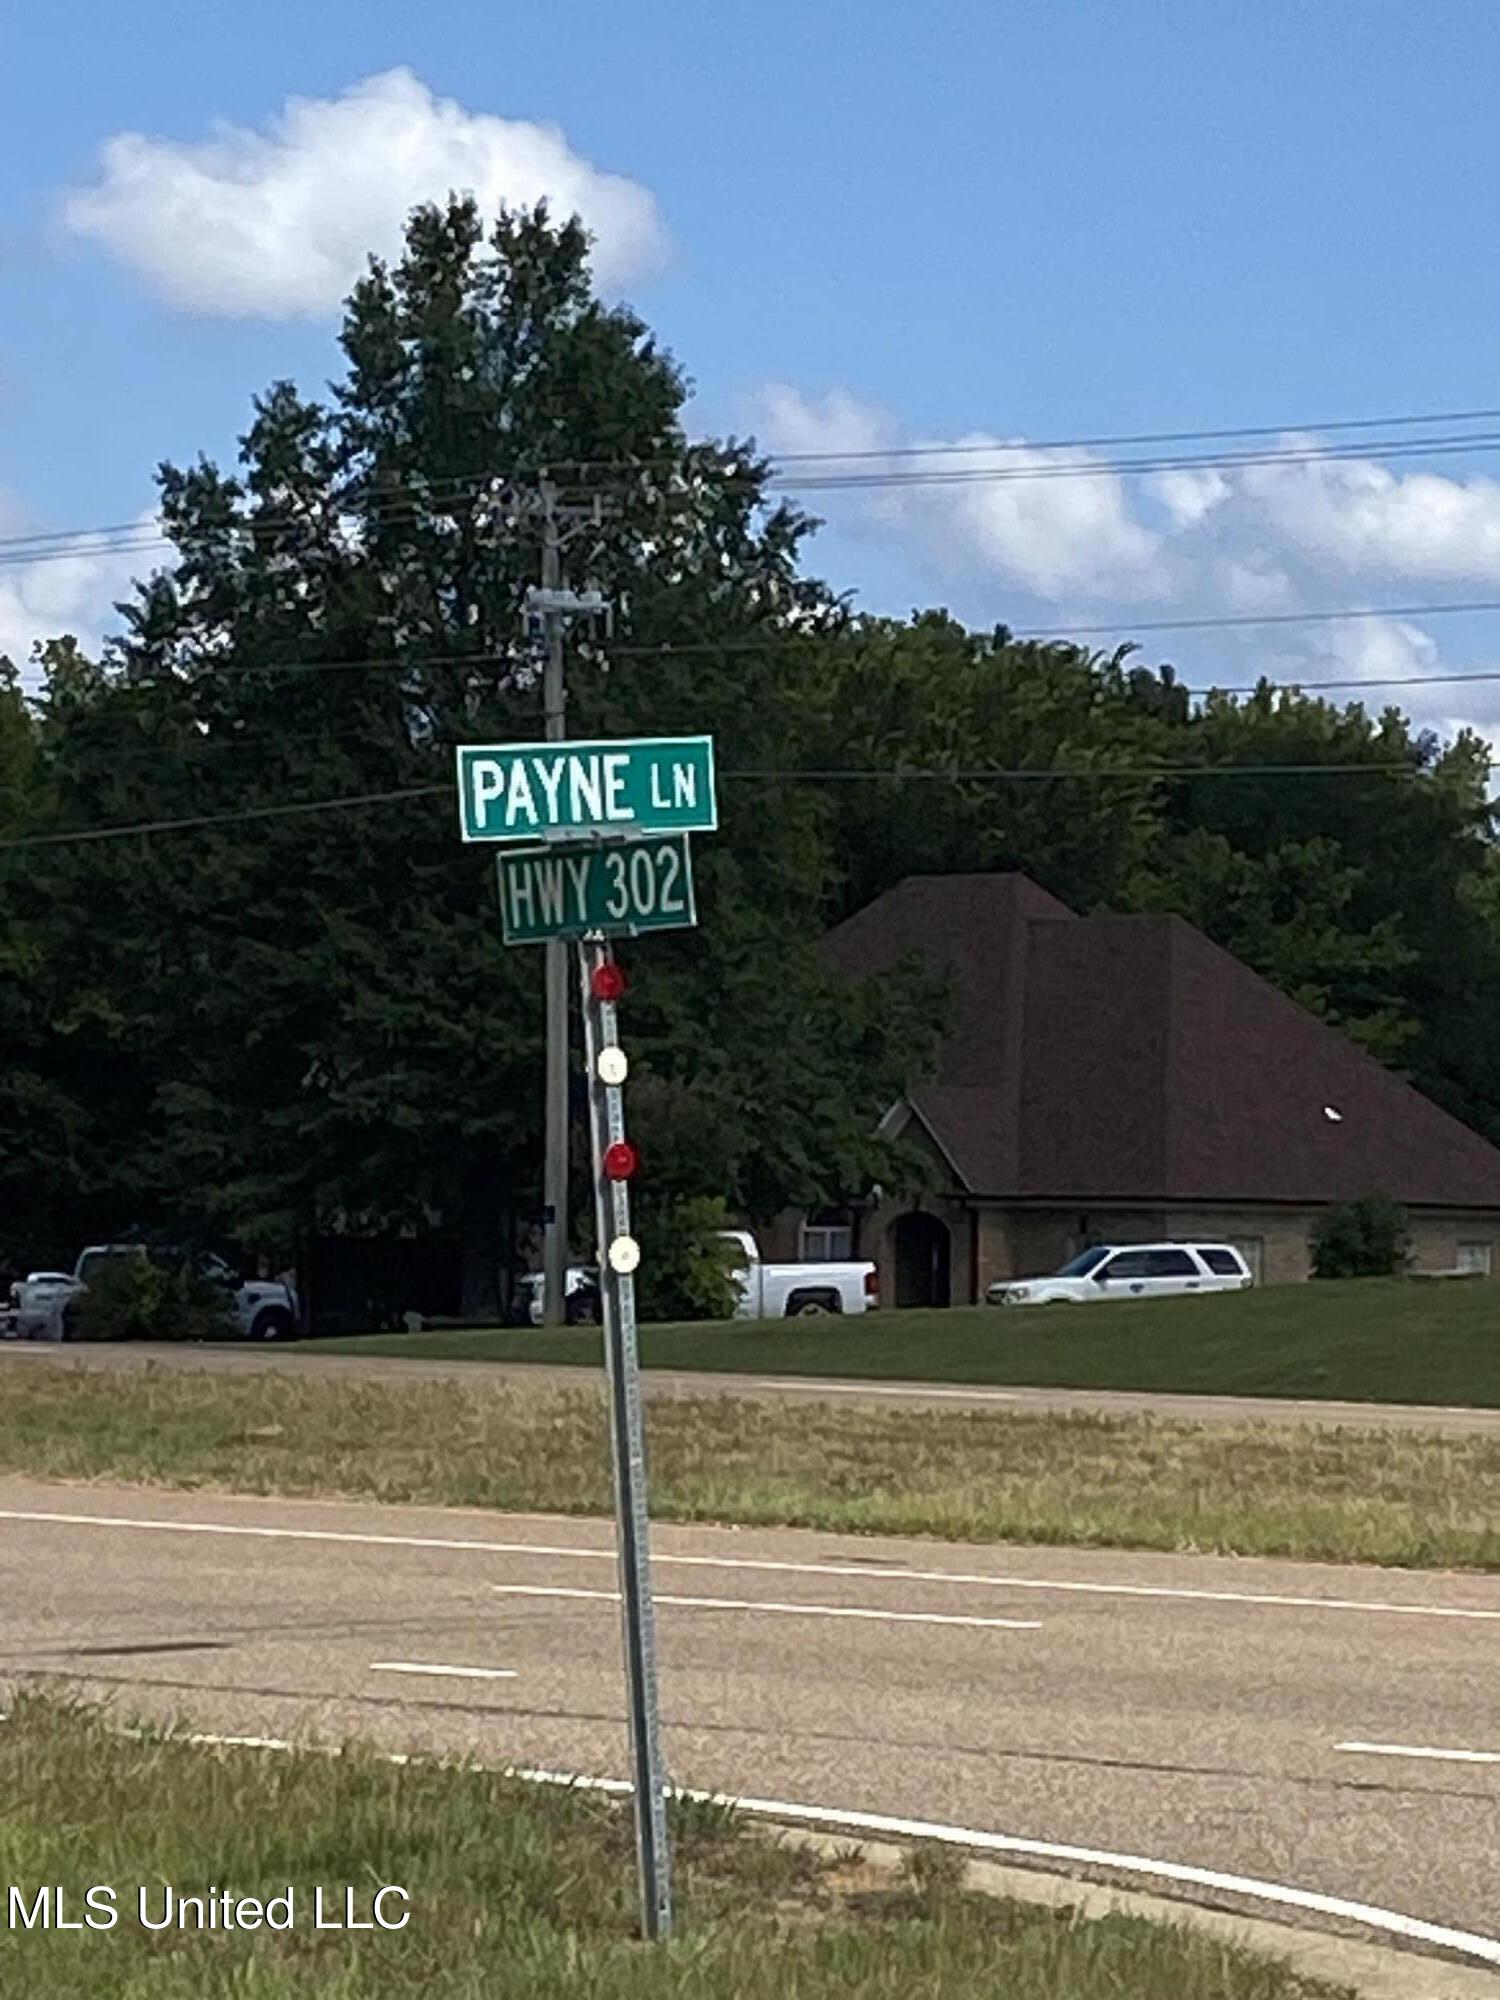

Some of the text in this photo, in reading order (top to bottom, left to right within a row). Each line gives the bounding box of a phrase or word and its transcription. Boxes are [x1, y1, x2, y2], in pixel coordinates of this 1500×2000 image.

[471, 754, 697, 829] PAYNE LN
[508, 845, 685, 929] HWY 302
